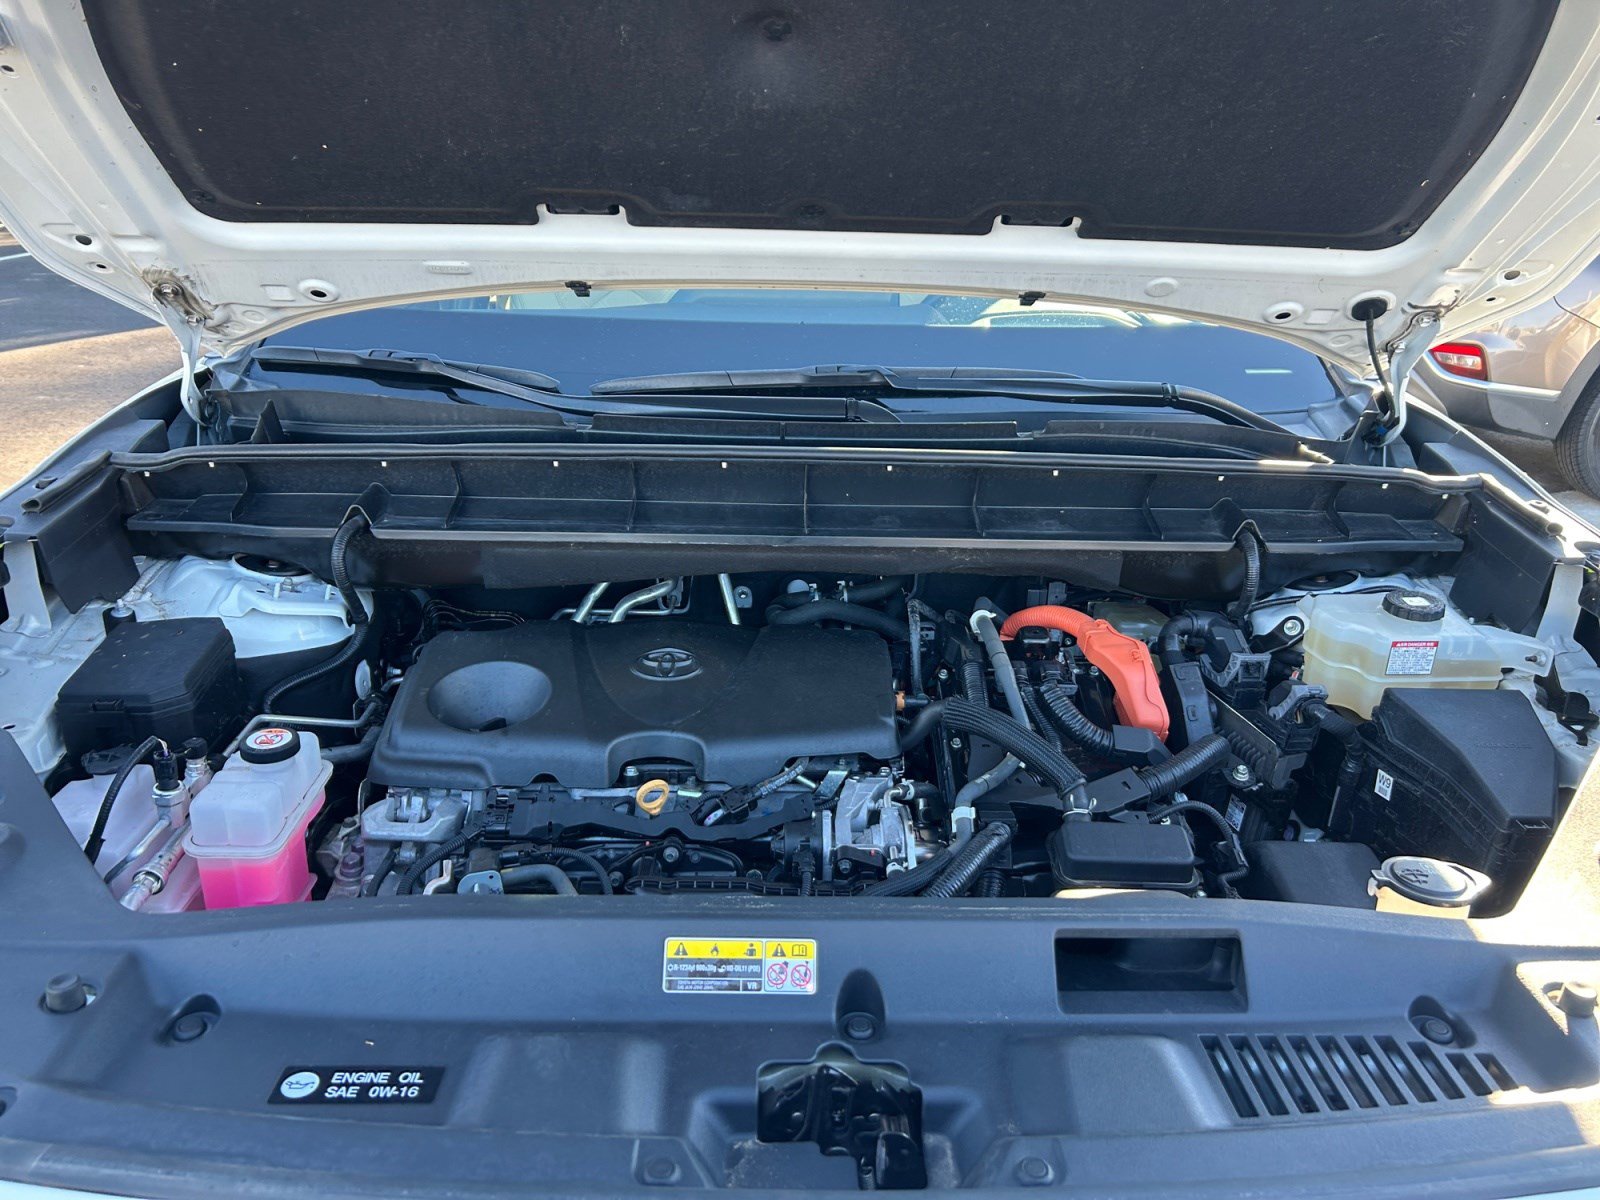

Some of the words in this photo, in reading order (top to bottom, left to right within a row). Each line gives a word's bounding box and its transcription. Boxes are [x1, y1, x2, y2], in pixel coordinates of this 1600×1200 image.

[746, 981, 758, 990] VR
[331, 1071, 391, 1084] ENGINE
[398, 1071, 425, 1084] OIL
[324, 1086, 360, 1098] SAE
[367, 1086, 419, 1098] 0W-16
